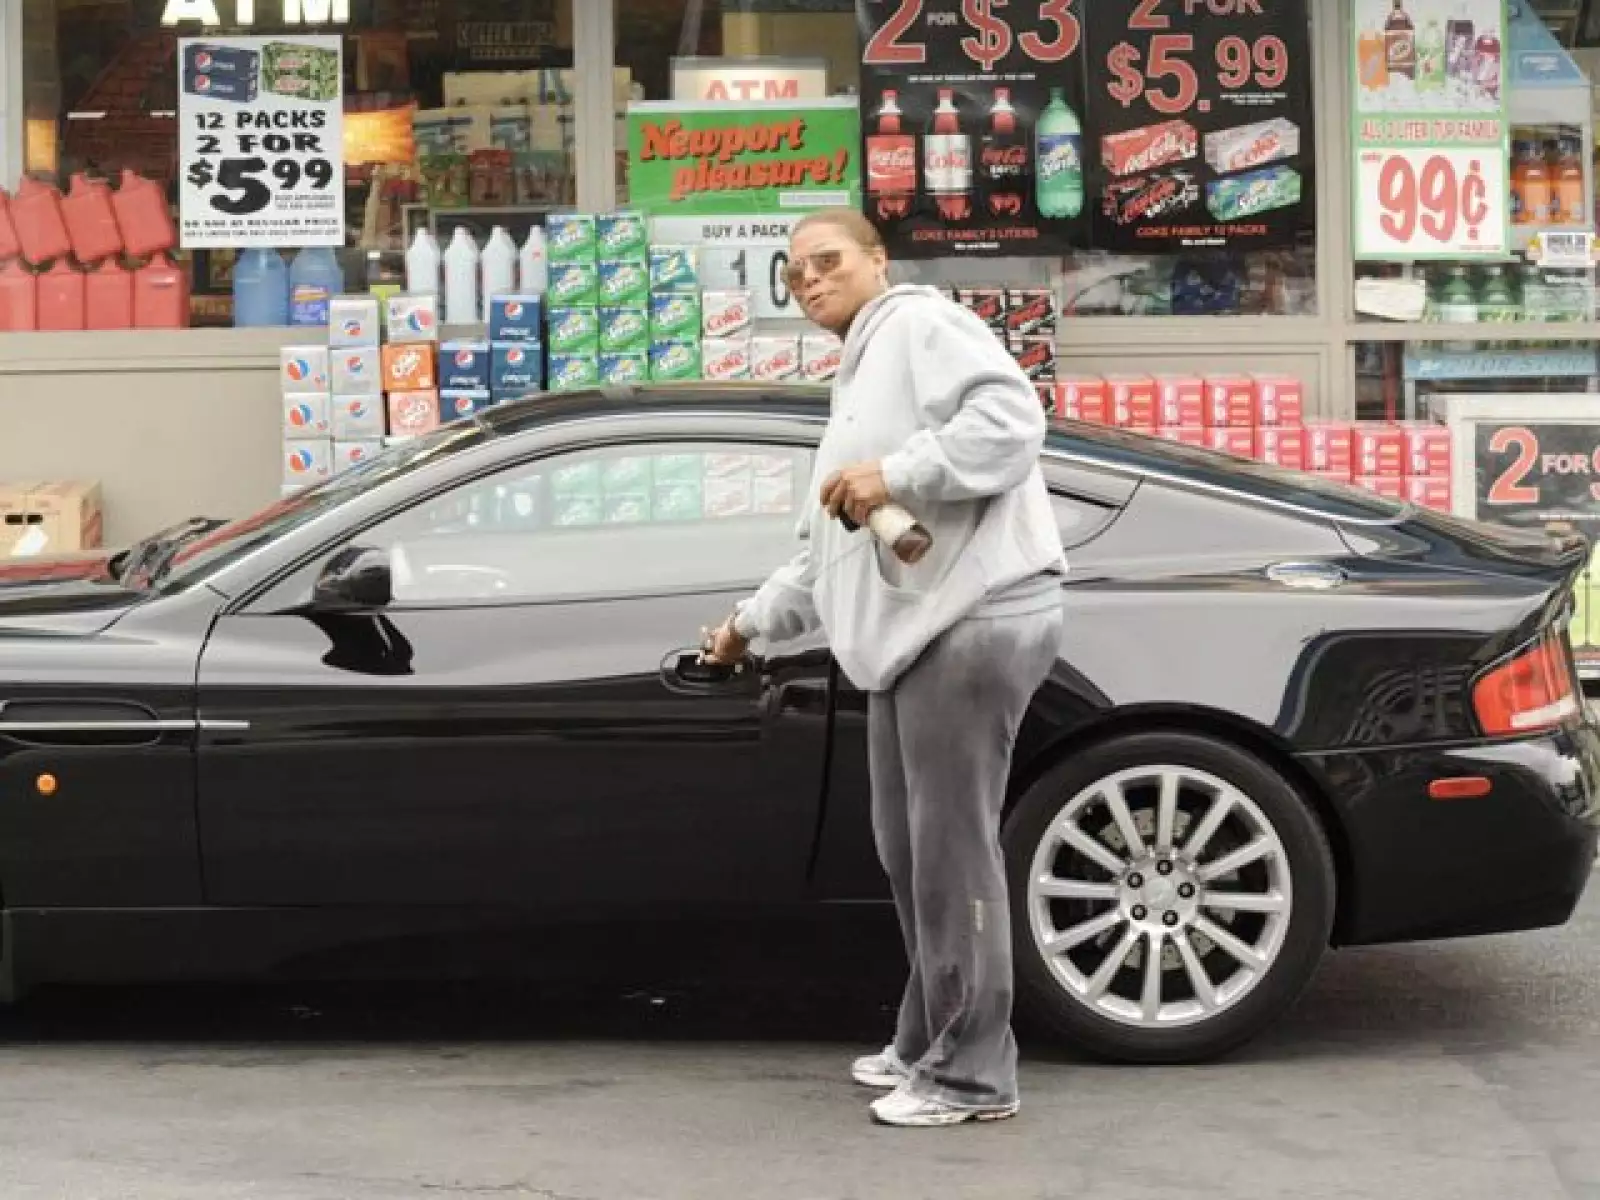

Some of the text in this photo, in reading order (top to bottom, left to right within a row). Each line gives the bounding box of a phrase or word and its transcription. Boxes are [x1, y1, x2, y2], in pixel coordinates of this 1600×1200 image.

[862, 0, 926, 63] 2
[927, 12, 957, 25] FOR
[704, 80, 798, 100] ATM
[195, 110, 326, 129] 12 PACKS
[197, 133, 323, 153] 2 FOR
[640, 118, 806, 164] Newport
[669, 147, 848, 201] pleasure!
[702, 224, 788, 238] BUY A PACK
[1488, 426, 1540, 505] 2
[1541, 453, 1590, 475] FOR
